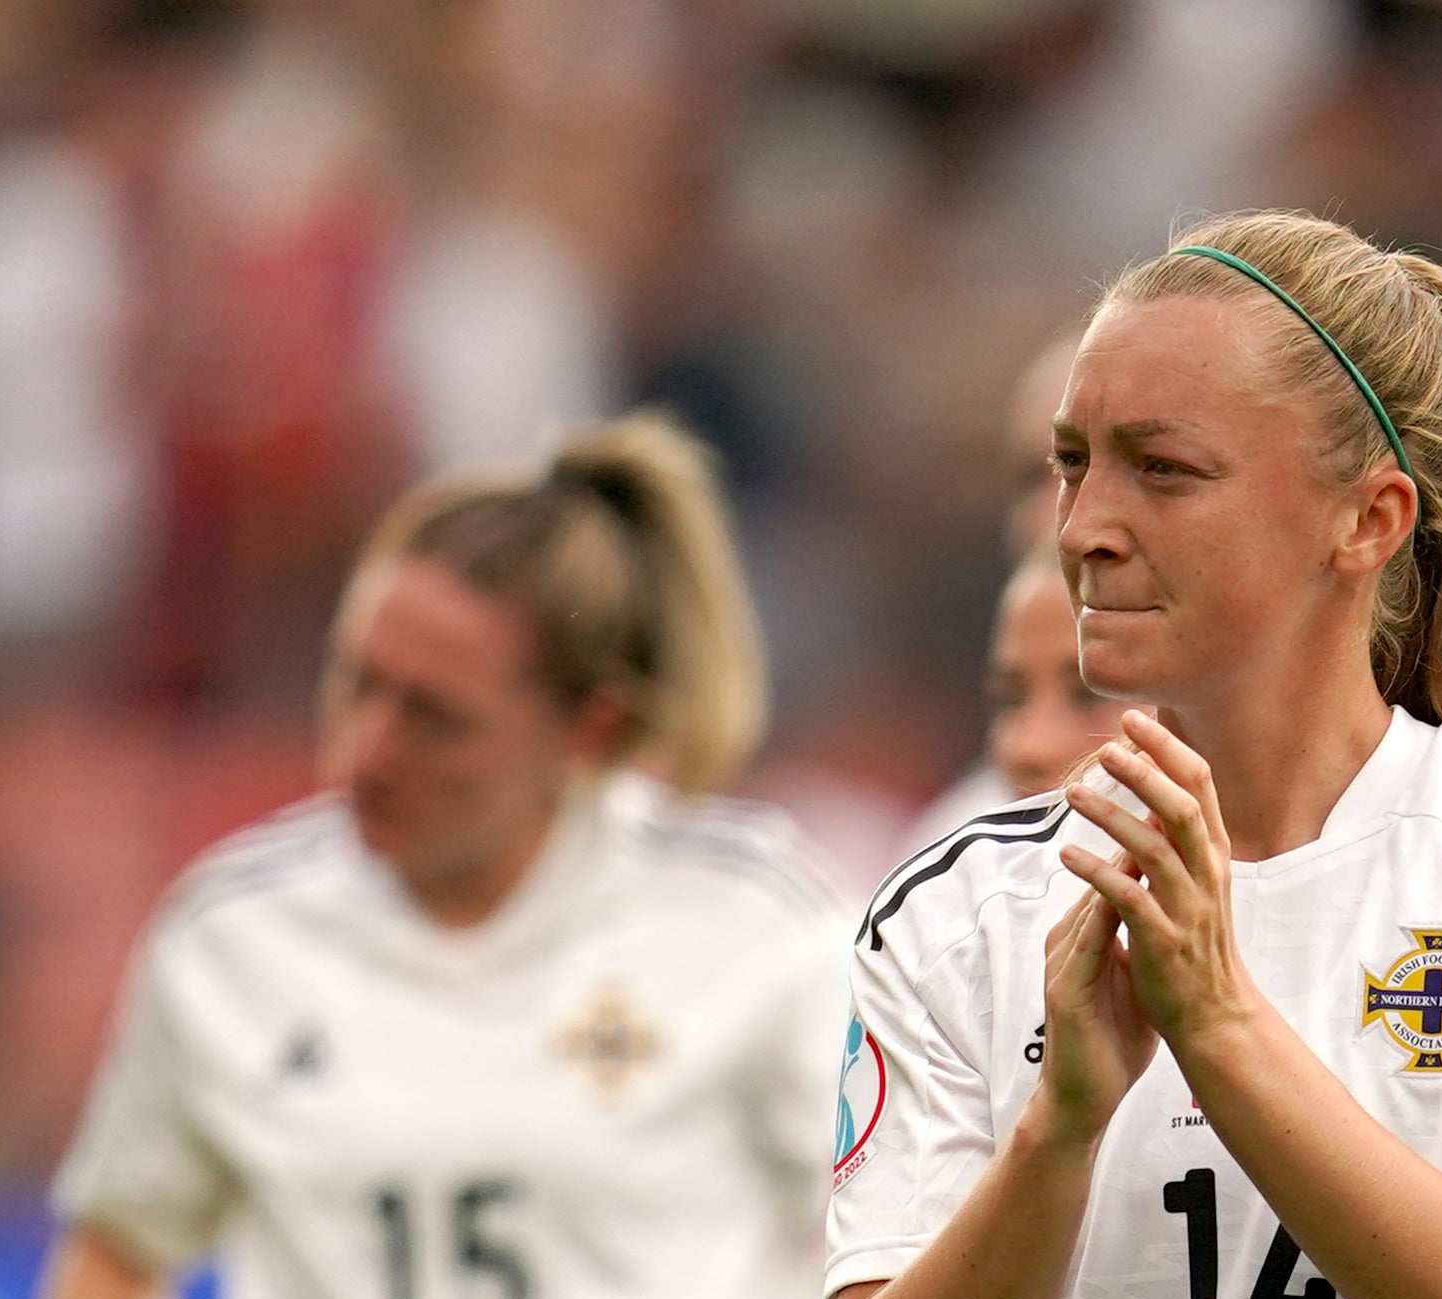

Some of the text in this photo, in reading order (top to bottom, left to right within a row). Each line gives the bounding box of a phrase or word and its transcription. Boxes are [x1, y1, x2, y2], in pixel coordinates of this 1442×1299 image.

[1392, 959, 1421, 985] IRISH
[1380, 994, 1437, 1007] NORTHERN
[1171, 1117, 1182, 1128] ST
[844, 1150, 867, 1180] 2022
